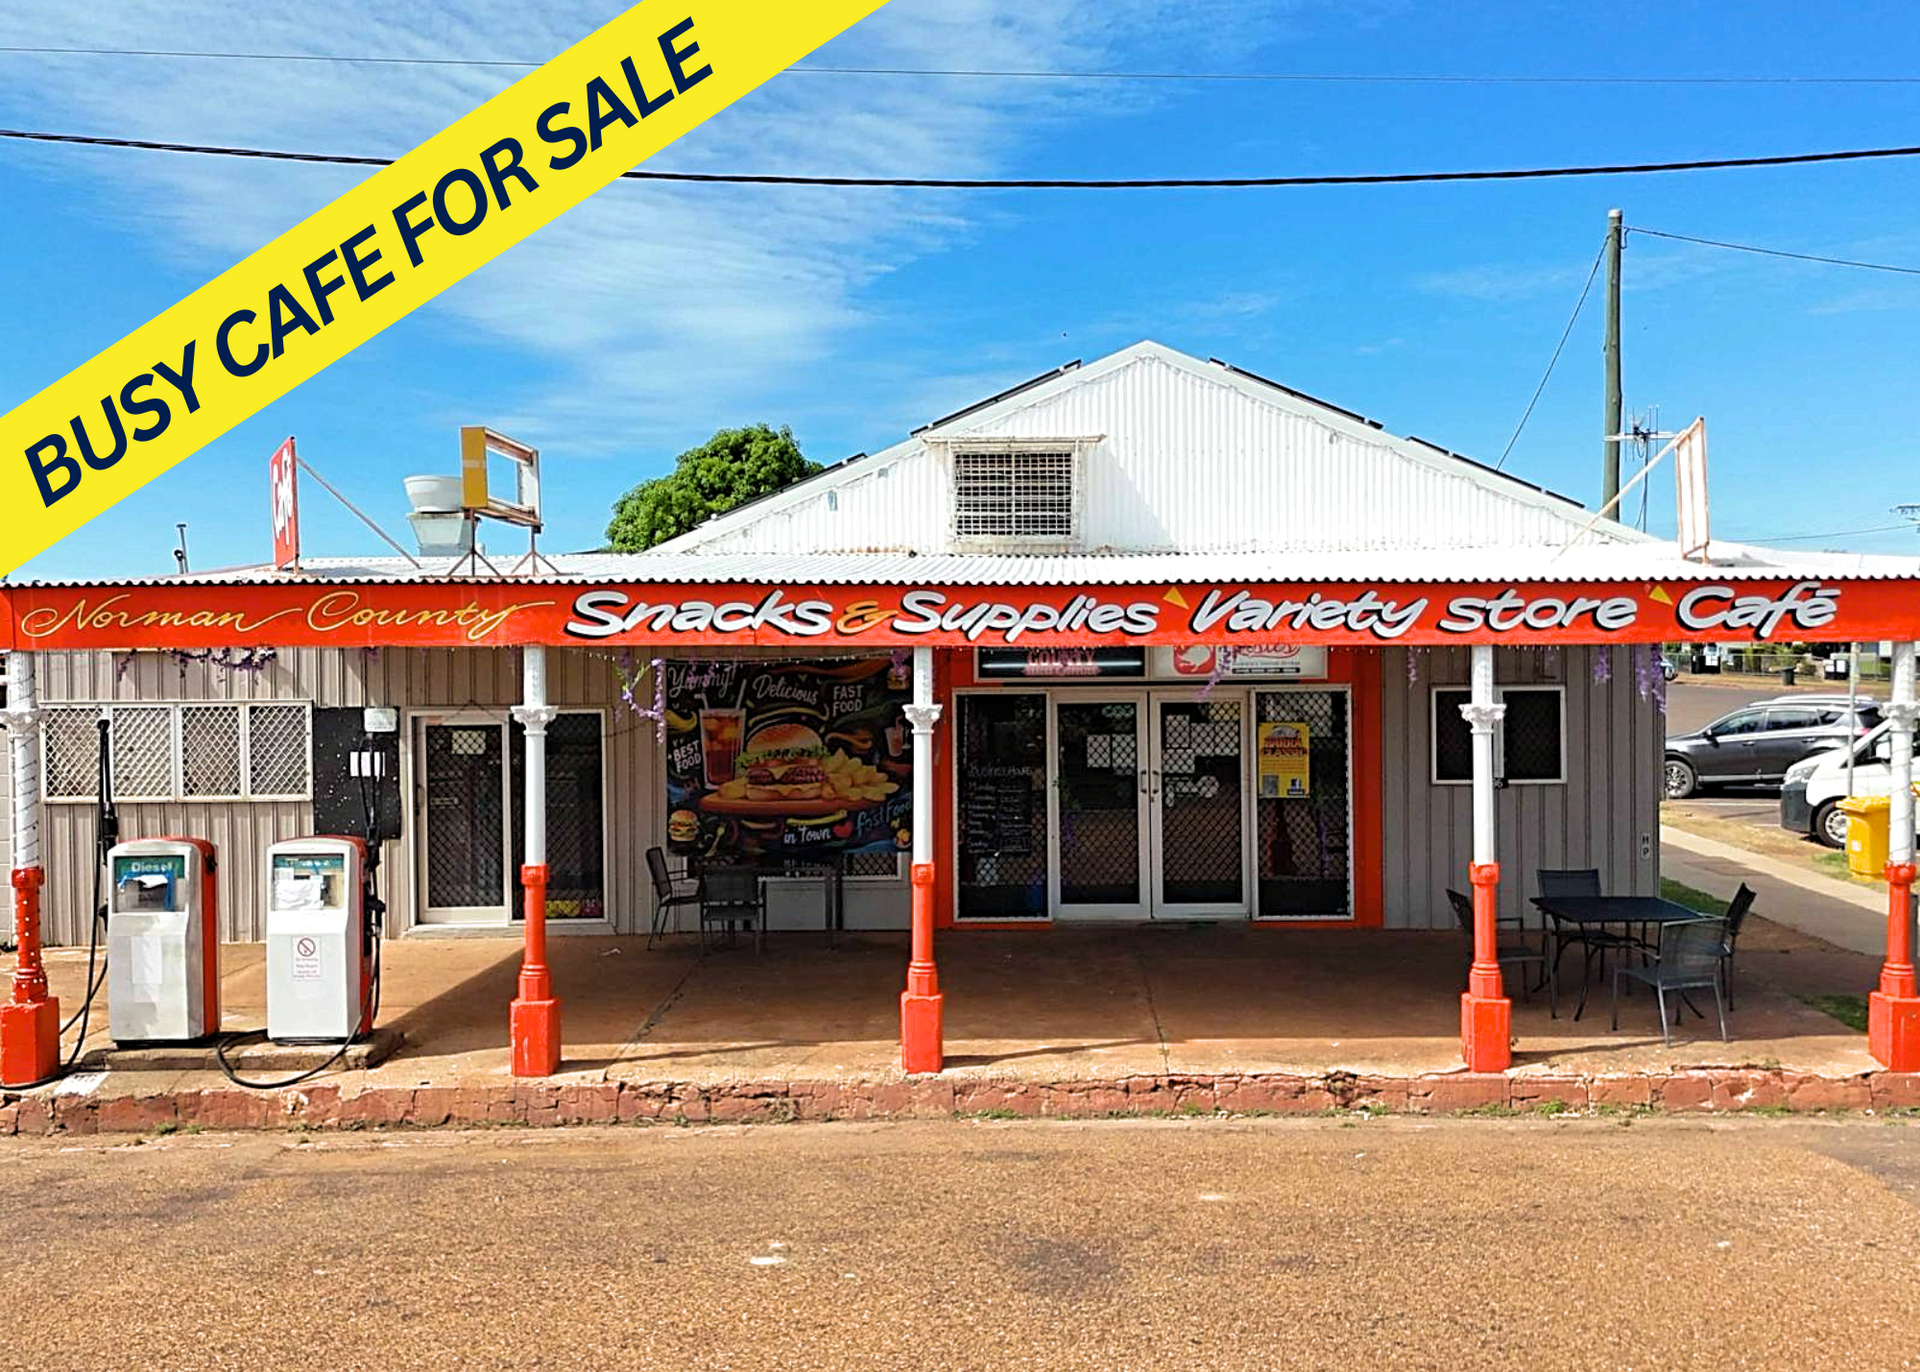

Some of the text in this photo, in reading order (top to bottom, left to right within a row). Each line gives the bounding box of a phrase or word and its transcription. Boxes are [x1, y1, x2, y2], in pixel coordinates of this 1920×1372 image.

[21, 594, 302, 638] Norman
[306, 590, 555, 640] County
[565, 589, 834, 636] Snacks
[835, 600, 898, 634] &
[892, 590, 1160, 643] Supplies
[1190, 589, 1428, 638] Variety
[1437, 588, 1638, 632] store
[752, 673, 819, 706] Delicious
[833, 685, 863, 700] FAST
[832, 699, 863, 717] FOOD
[673, 739, 700, 763] BEST
[675, 753, 702, 774] FOOD
[783, 825, 831, 844] in Town
[131, 861, 173, 873] Diesel
